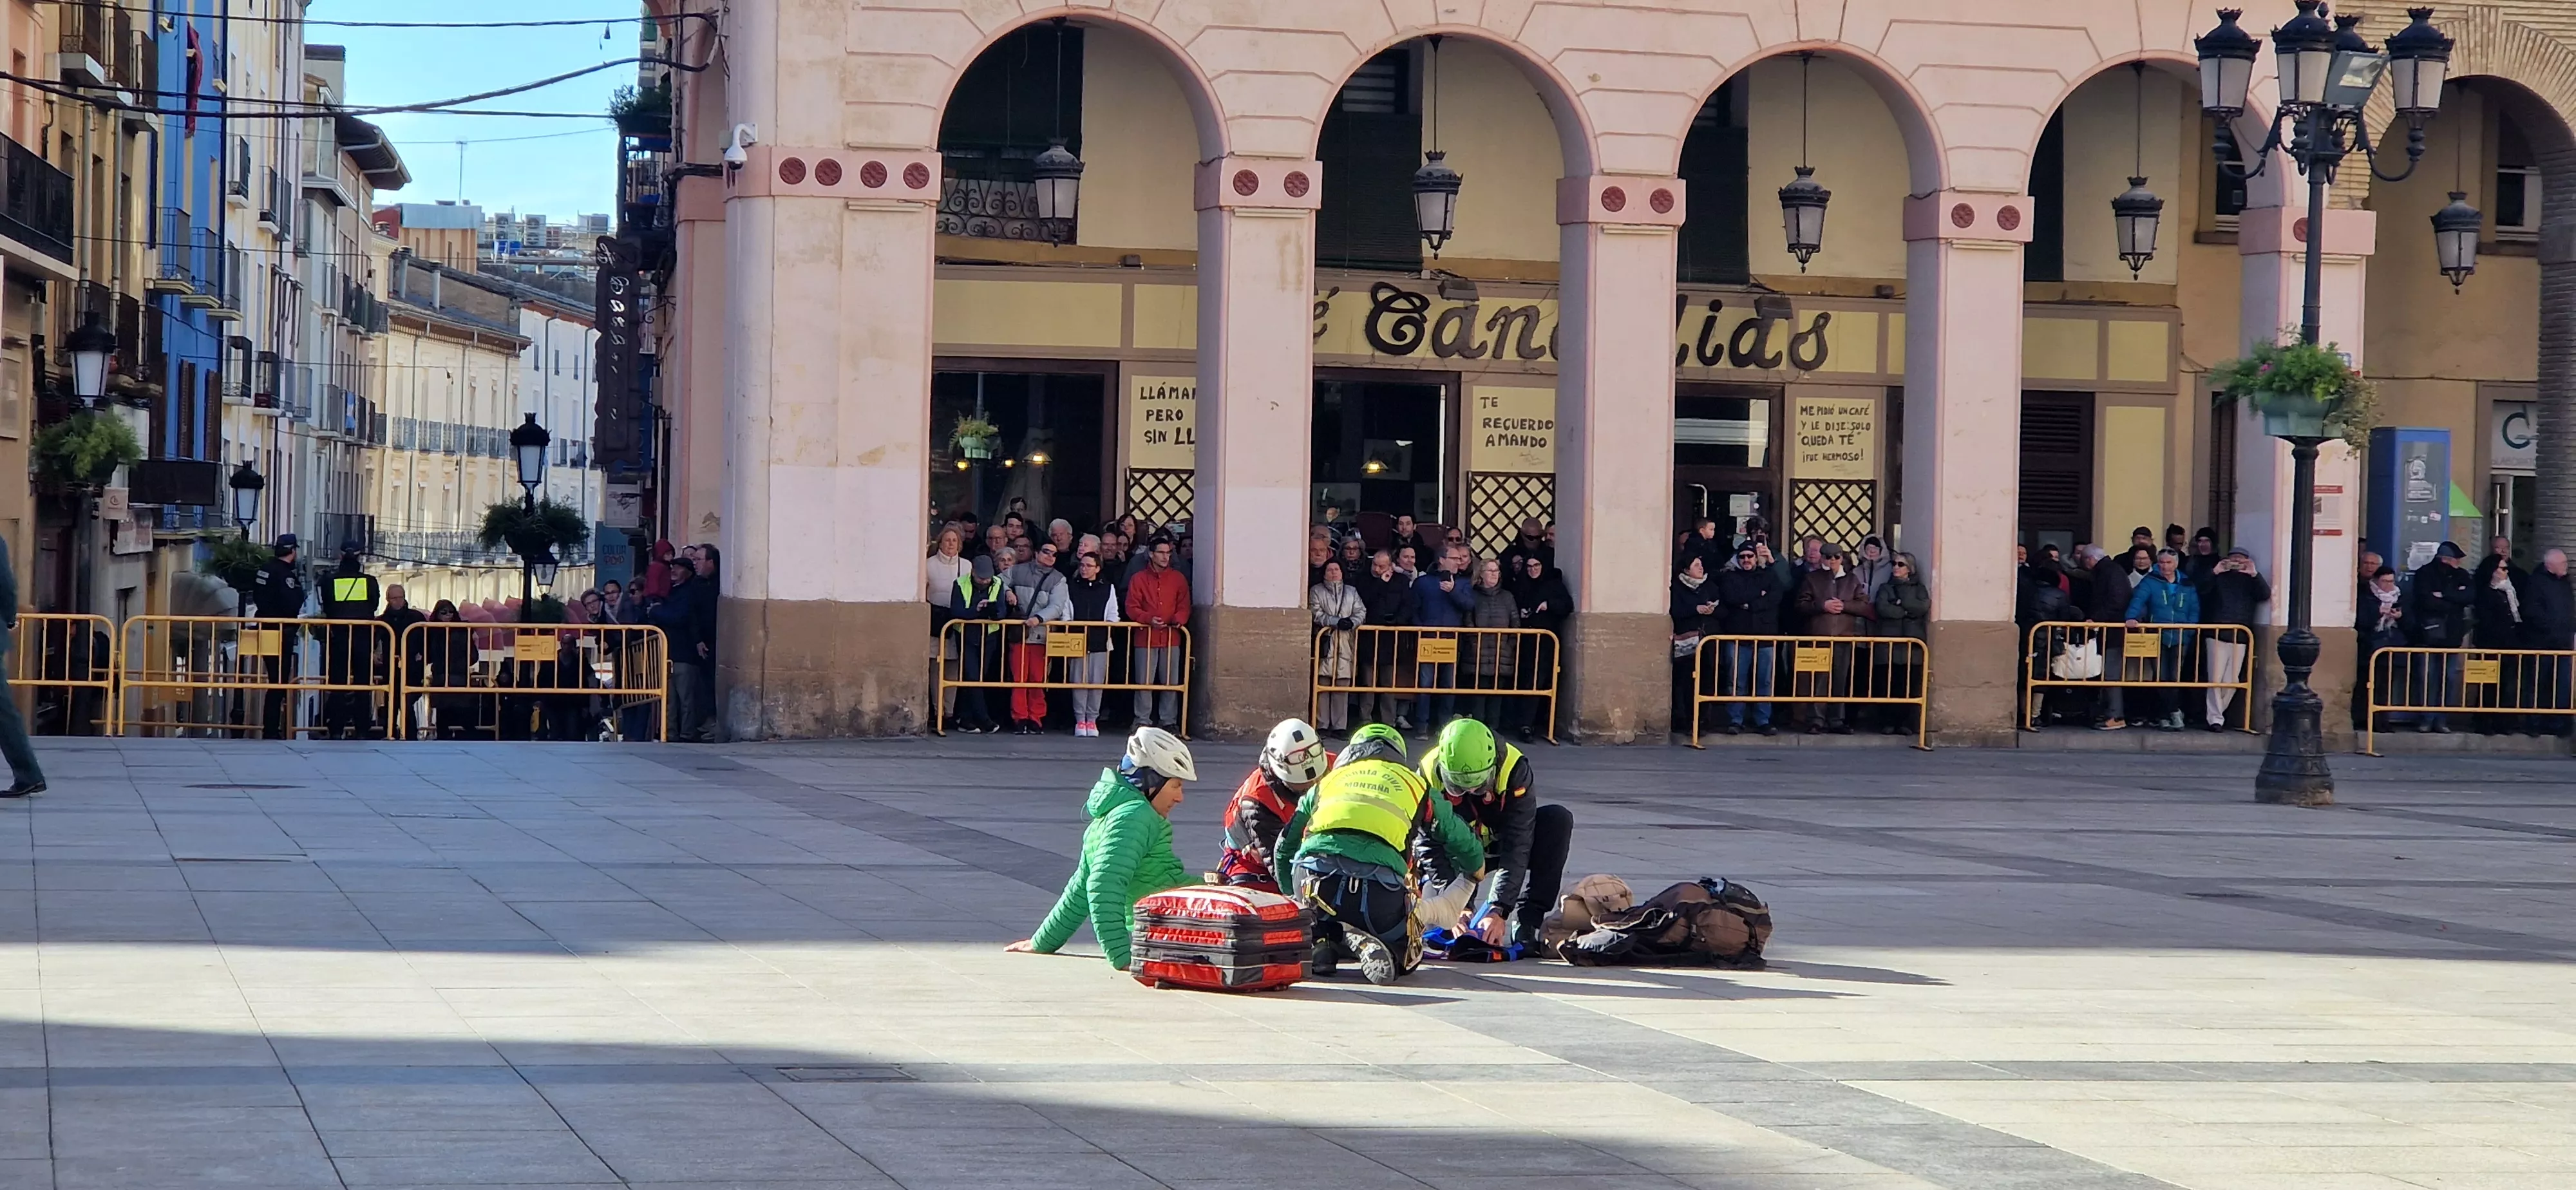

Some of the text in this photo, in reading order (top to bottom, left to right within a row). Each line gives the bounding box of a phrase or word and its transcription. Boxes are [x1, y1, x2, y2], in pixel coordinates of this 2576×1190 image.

[1480, 397, 1499, 409] TE
[1800, 403, 1870, 416] ME PIDIÓ UN CAFÉ
[1146, 409, 1183, 422] PERO
[1482, 417, 1554, 431] RECUERDO
[1801, 420, 1807, 431] Y
[1811, 421, 1819, 430] LE
[1144, 427, 1195, 445] SIN LL
[1485, 433, 1548, 448] AMANDO
[1823, 448, 1864, 462] HERMOSO!
[1381, 773, 1403, 792] CIVIL
